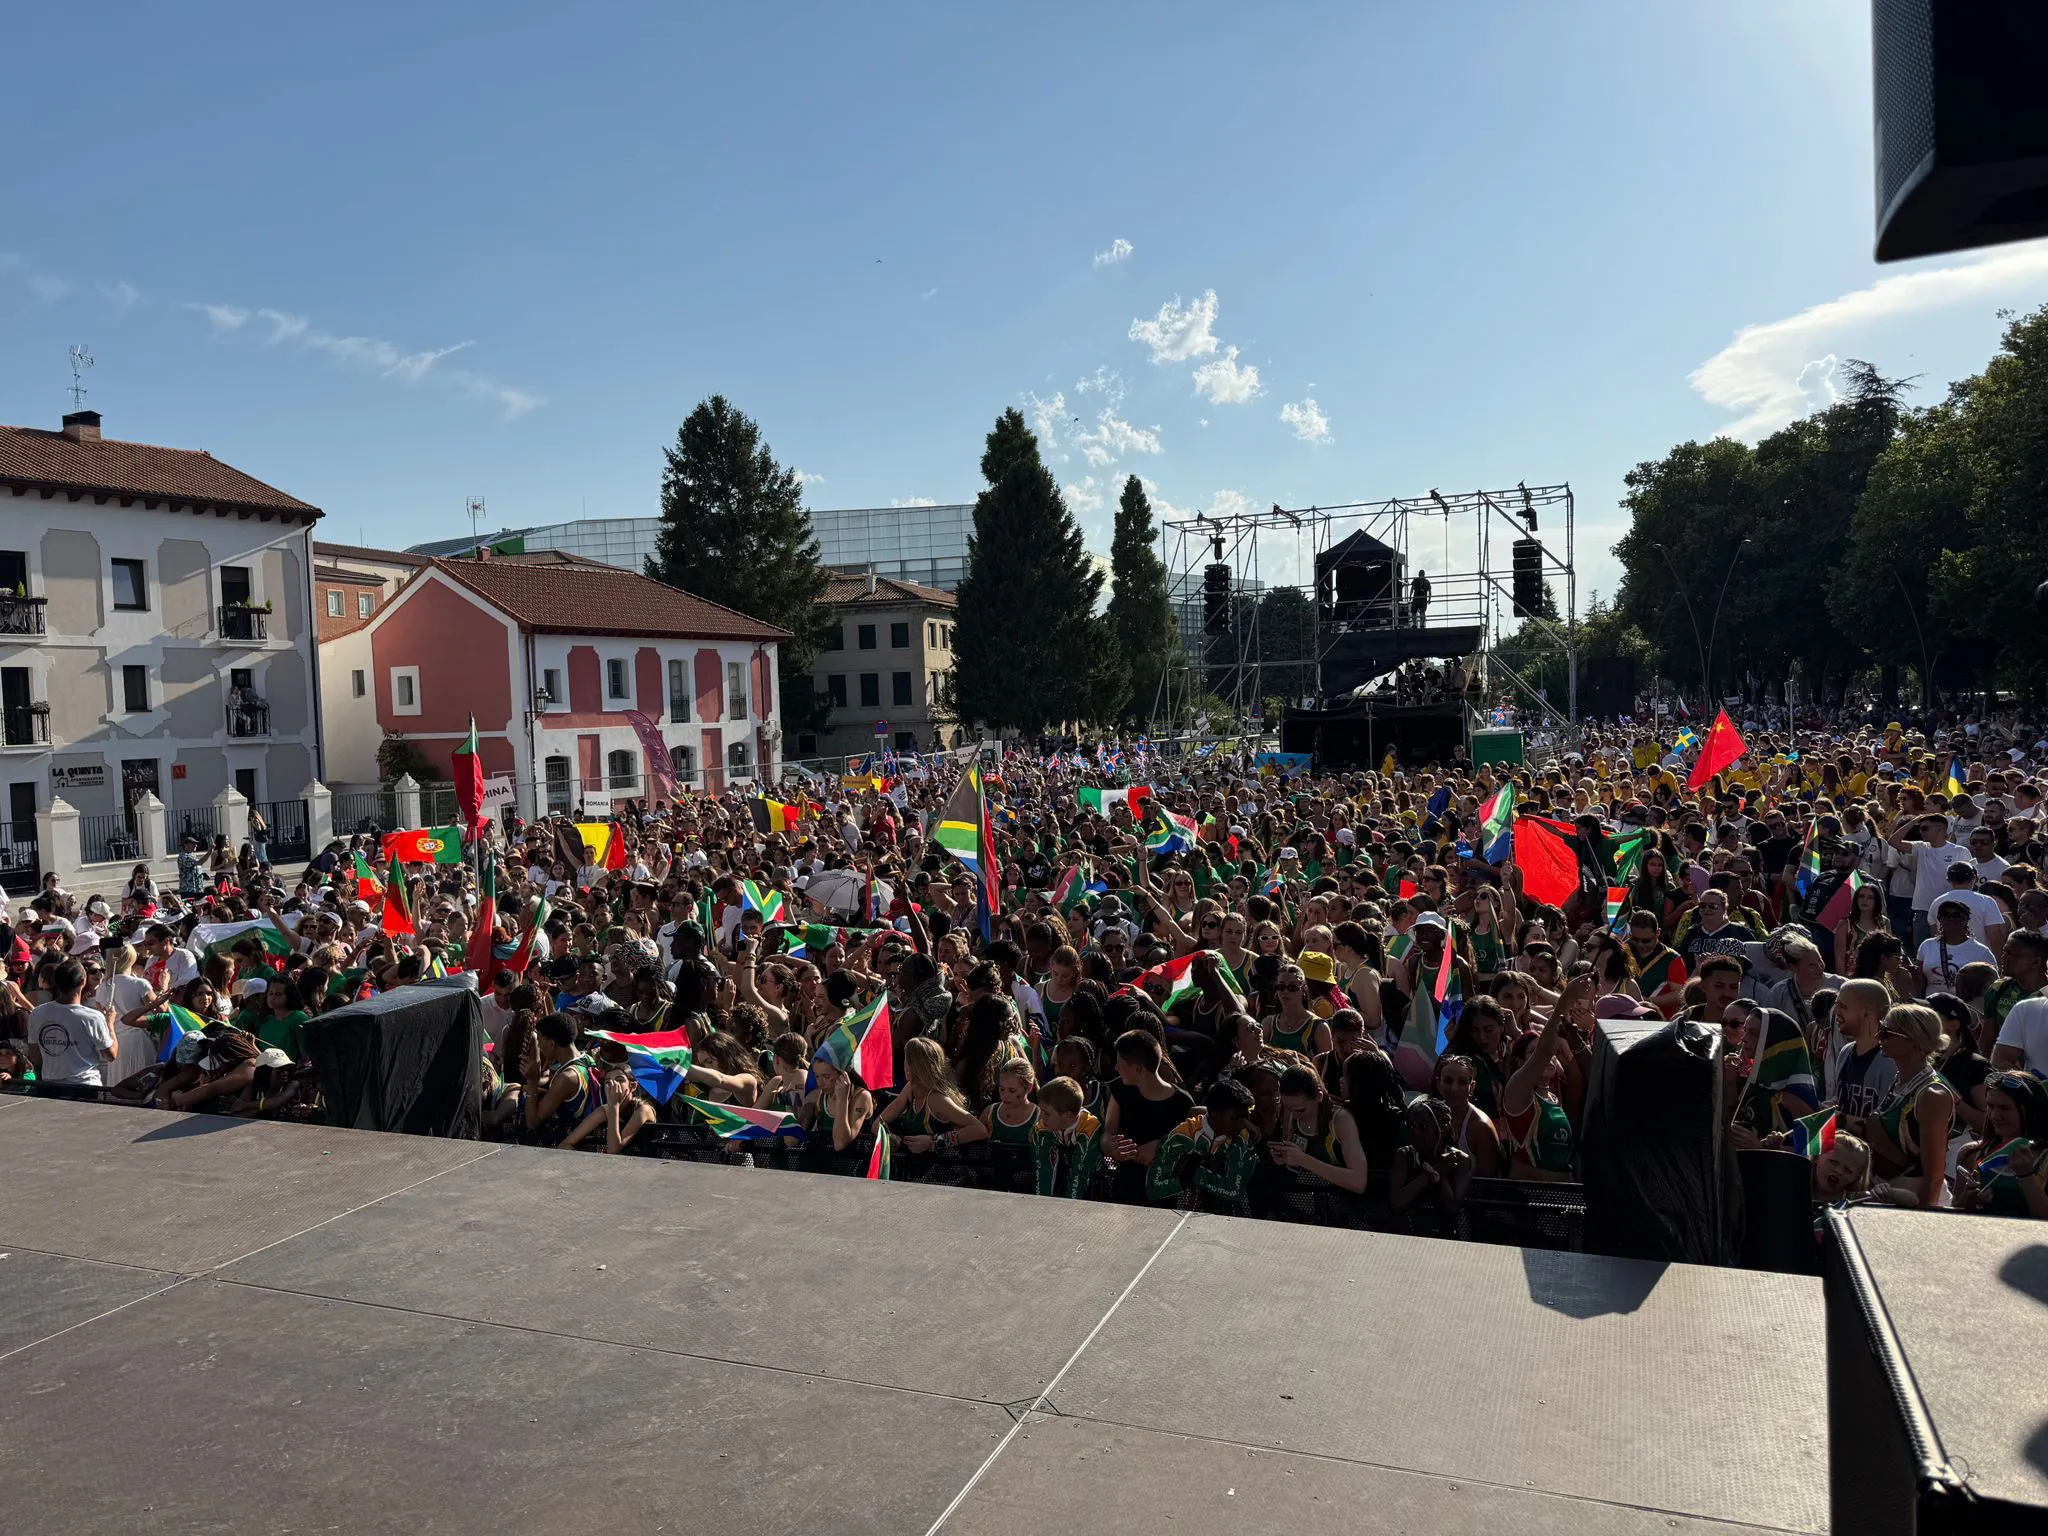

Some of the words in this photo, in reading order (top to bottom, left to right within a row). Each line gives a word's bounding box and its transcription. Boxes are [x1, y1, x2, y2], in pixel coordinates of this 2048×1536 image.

[52, 768, 65, 777] LA
[67, 766, 104, 778] QUINTA
[484, 785, 510, 799] HINA
